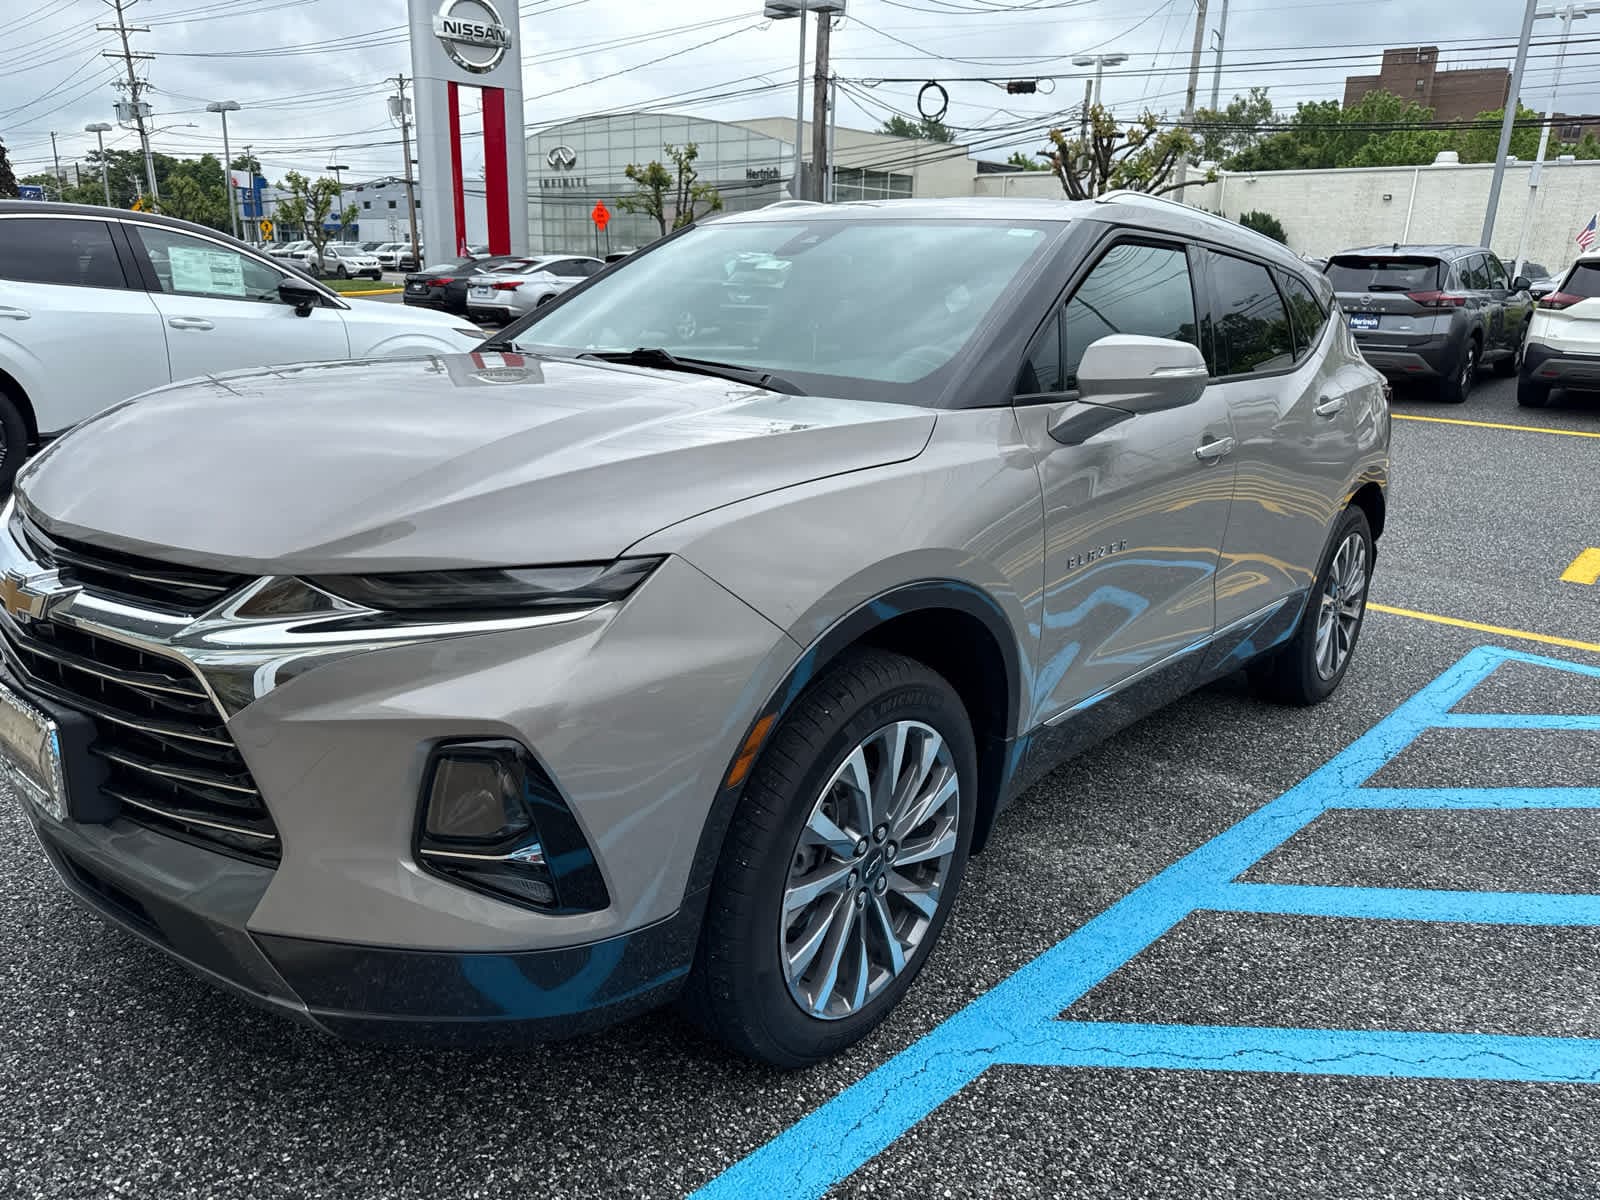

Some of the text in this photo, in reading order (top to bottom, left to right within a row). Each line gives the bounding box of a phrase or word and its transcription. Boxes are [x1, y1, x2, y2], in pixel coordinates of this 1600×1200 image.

[443, 20, 506, 42] NISSAN
[745, 166, 780, 180] Hertrich
[1067, 538, 1128, 569] BLAZER
